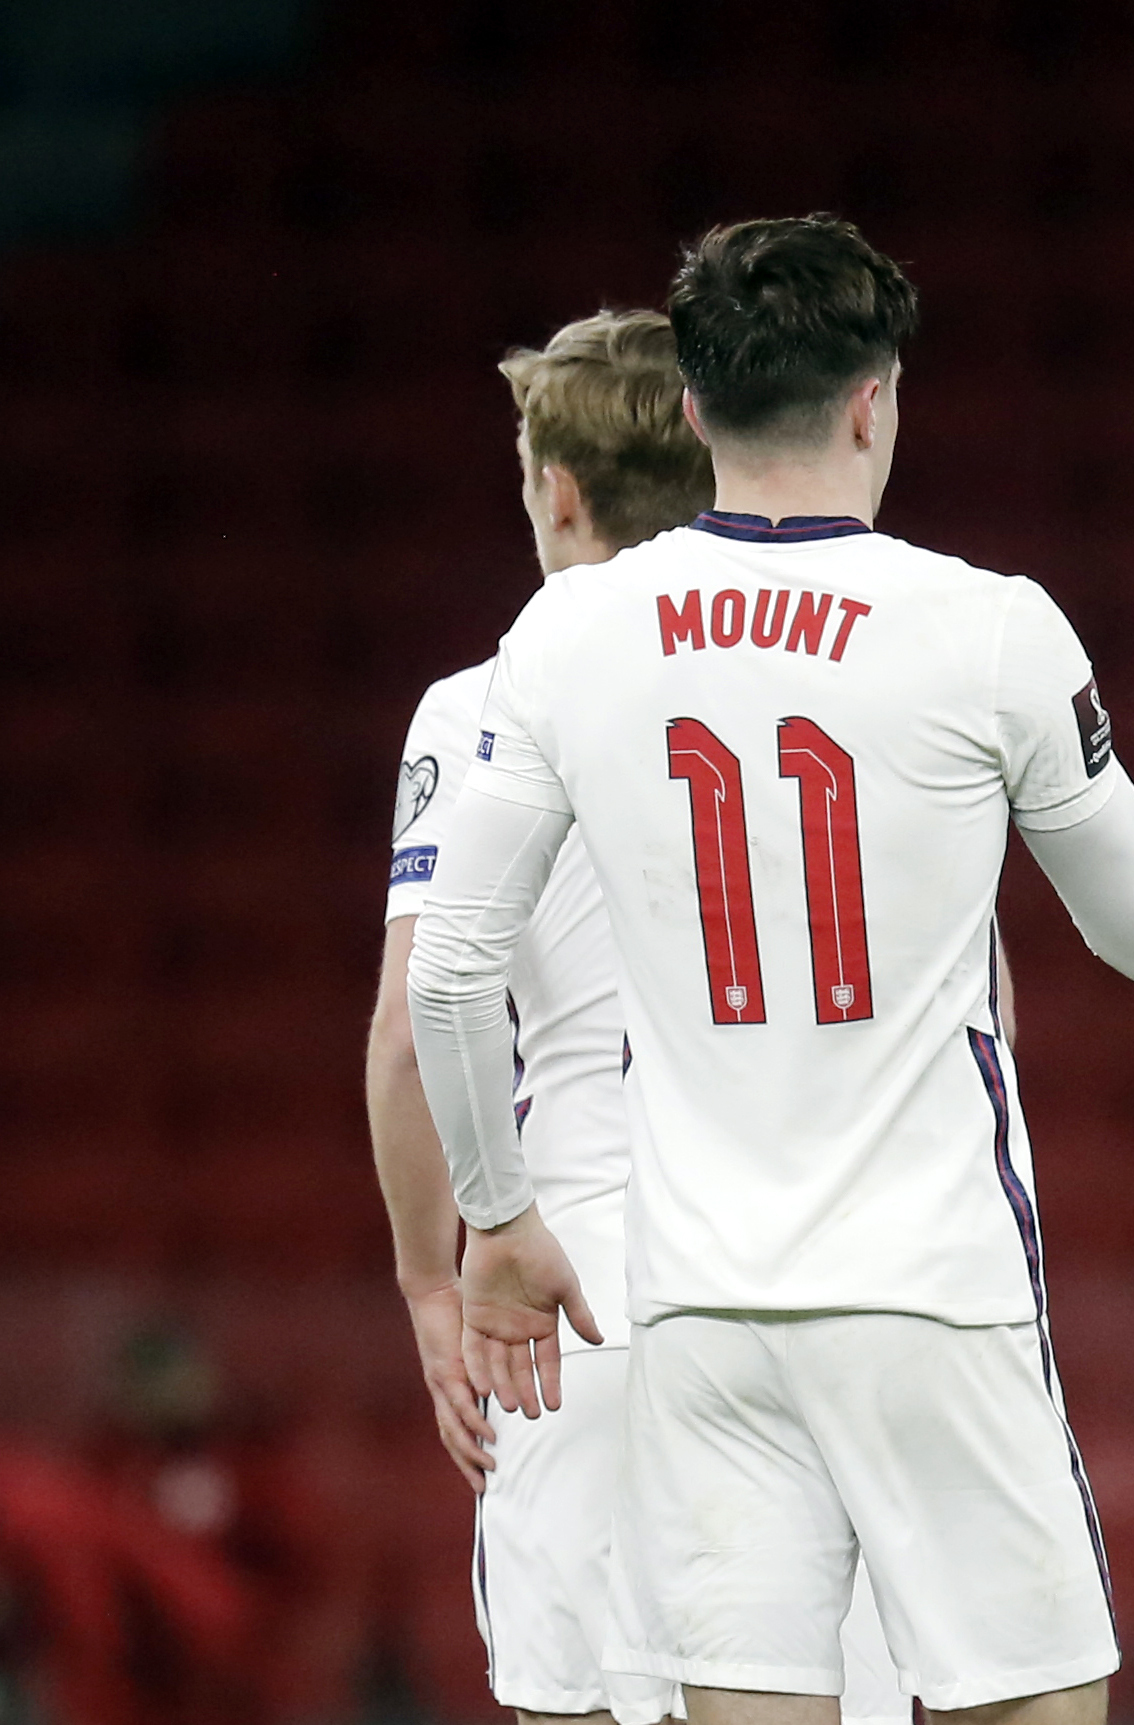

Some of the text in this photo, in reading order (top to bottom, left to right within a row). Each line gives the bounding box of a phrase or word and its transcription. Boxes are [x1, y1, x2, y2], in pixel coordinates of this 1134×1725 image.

[656, 588, 872, 663] MOUNT
[391, 856, 436, 878] ESPECT
[666, 716, 874, 1025] 11
